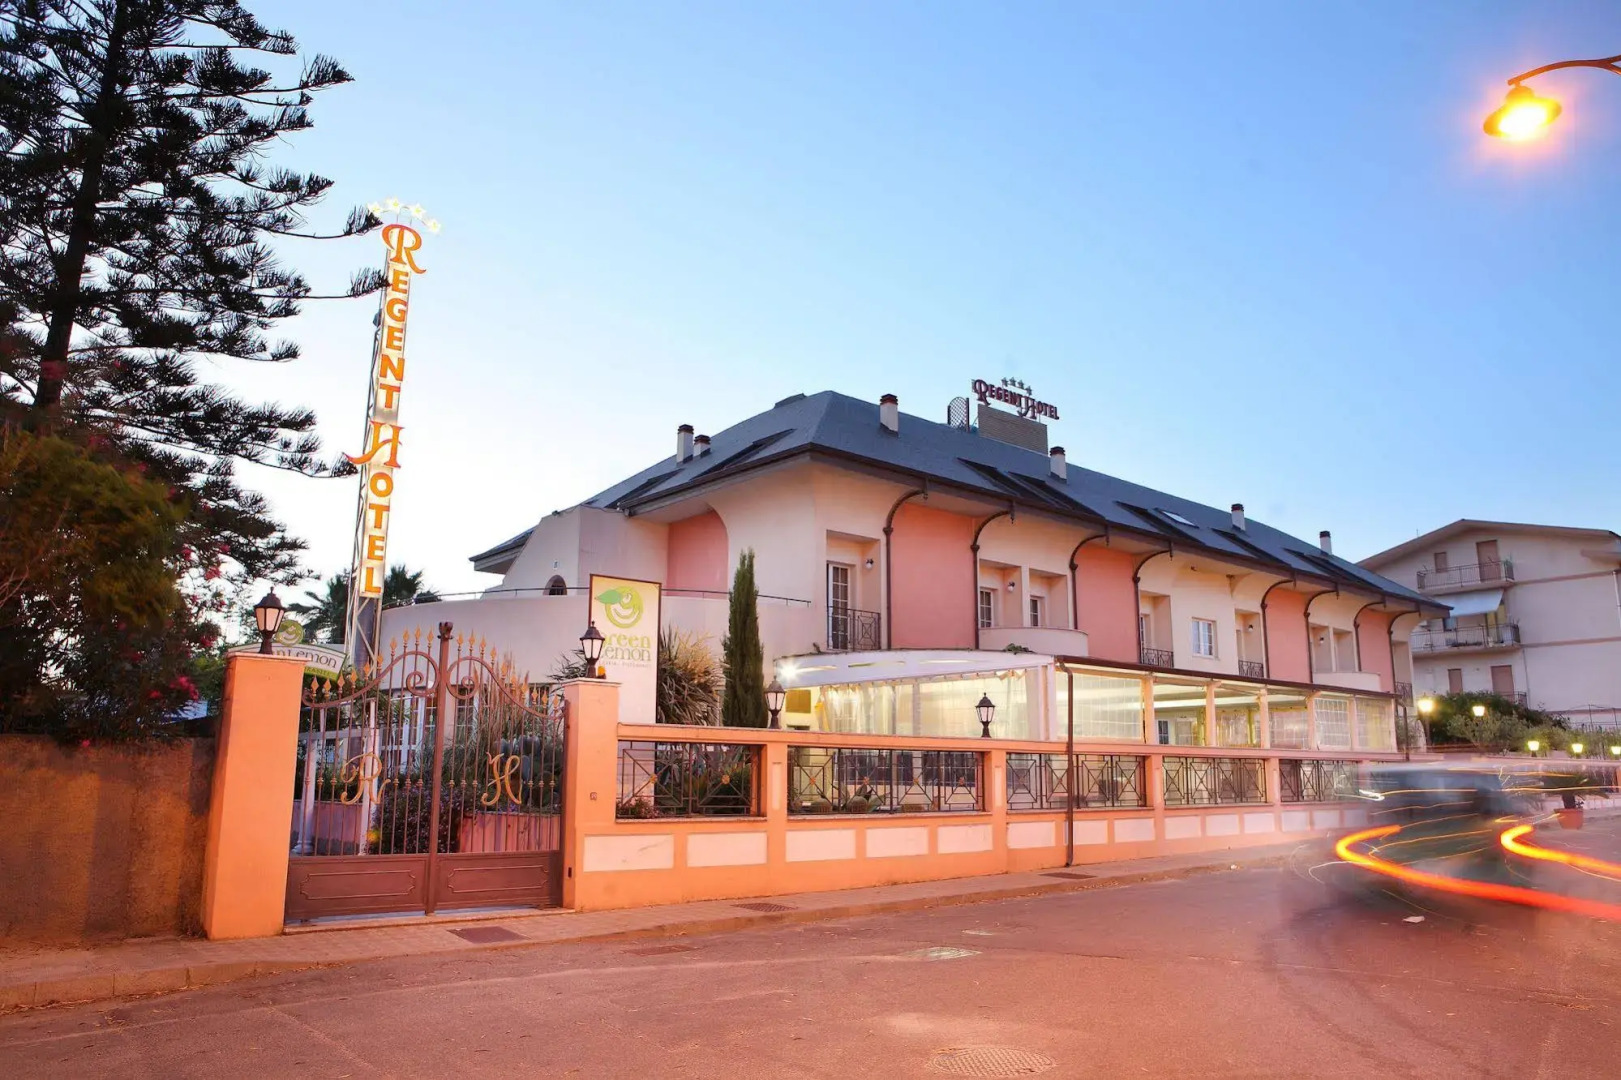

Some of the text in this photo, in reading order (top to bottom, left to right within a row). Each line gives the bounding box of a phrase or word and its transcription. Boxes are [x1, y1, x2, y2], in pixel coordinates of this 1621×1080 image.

[343, 224, 427, 593] REGENT HOTEL
[972, 379, 1060, 420] REGENT HOTEL
[601, 646, 652, 661] emon
